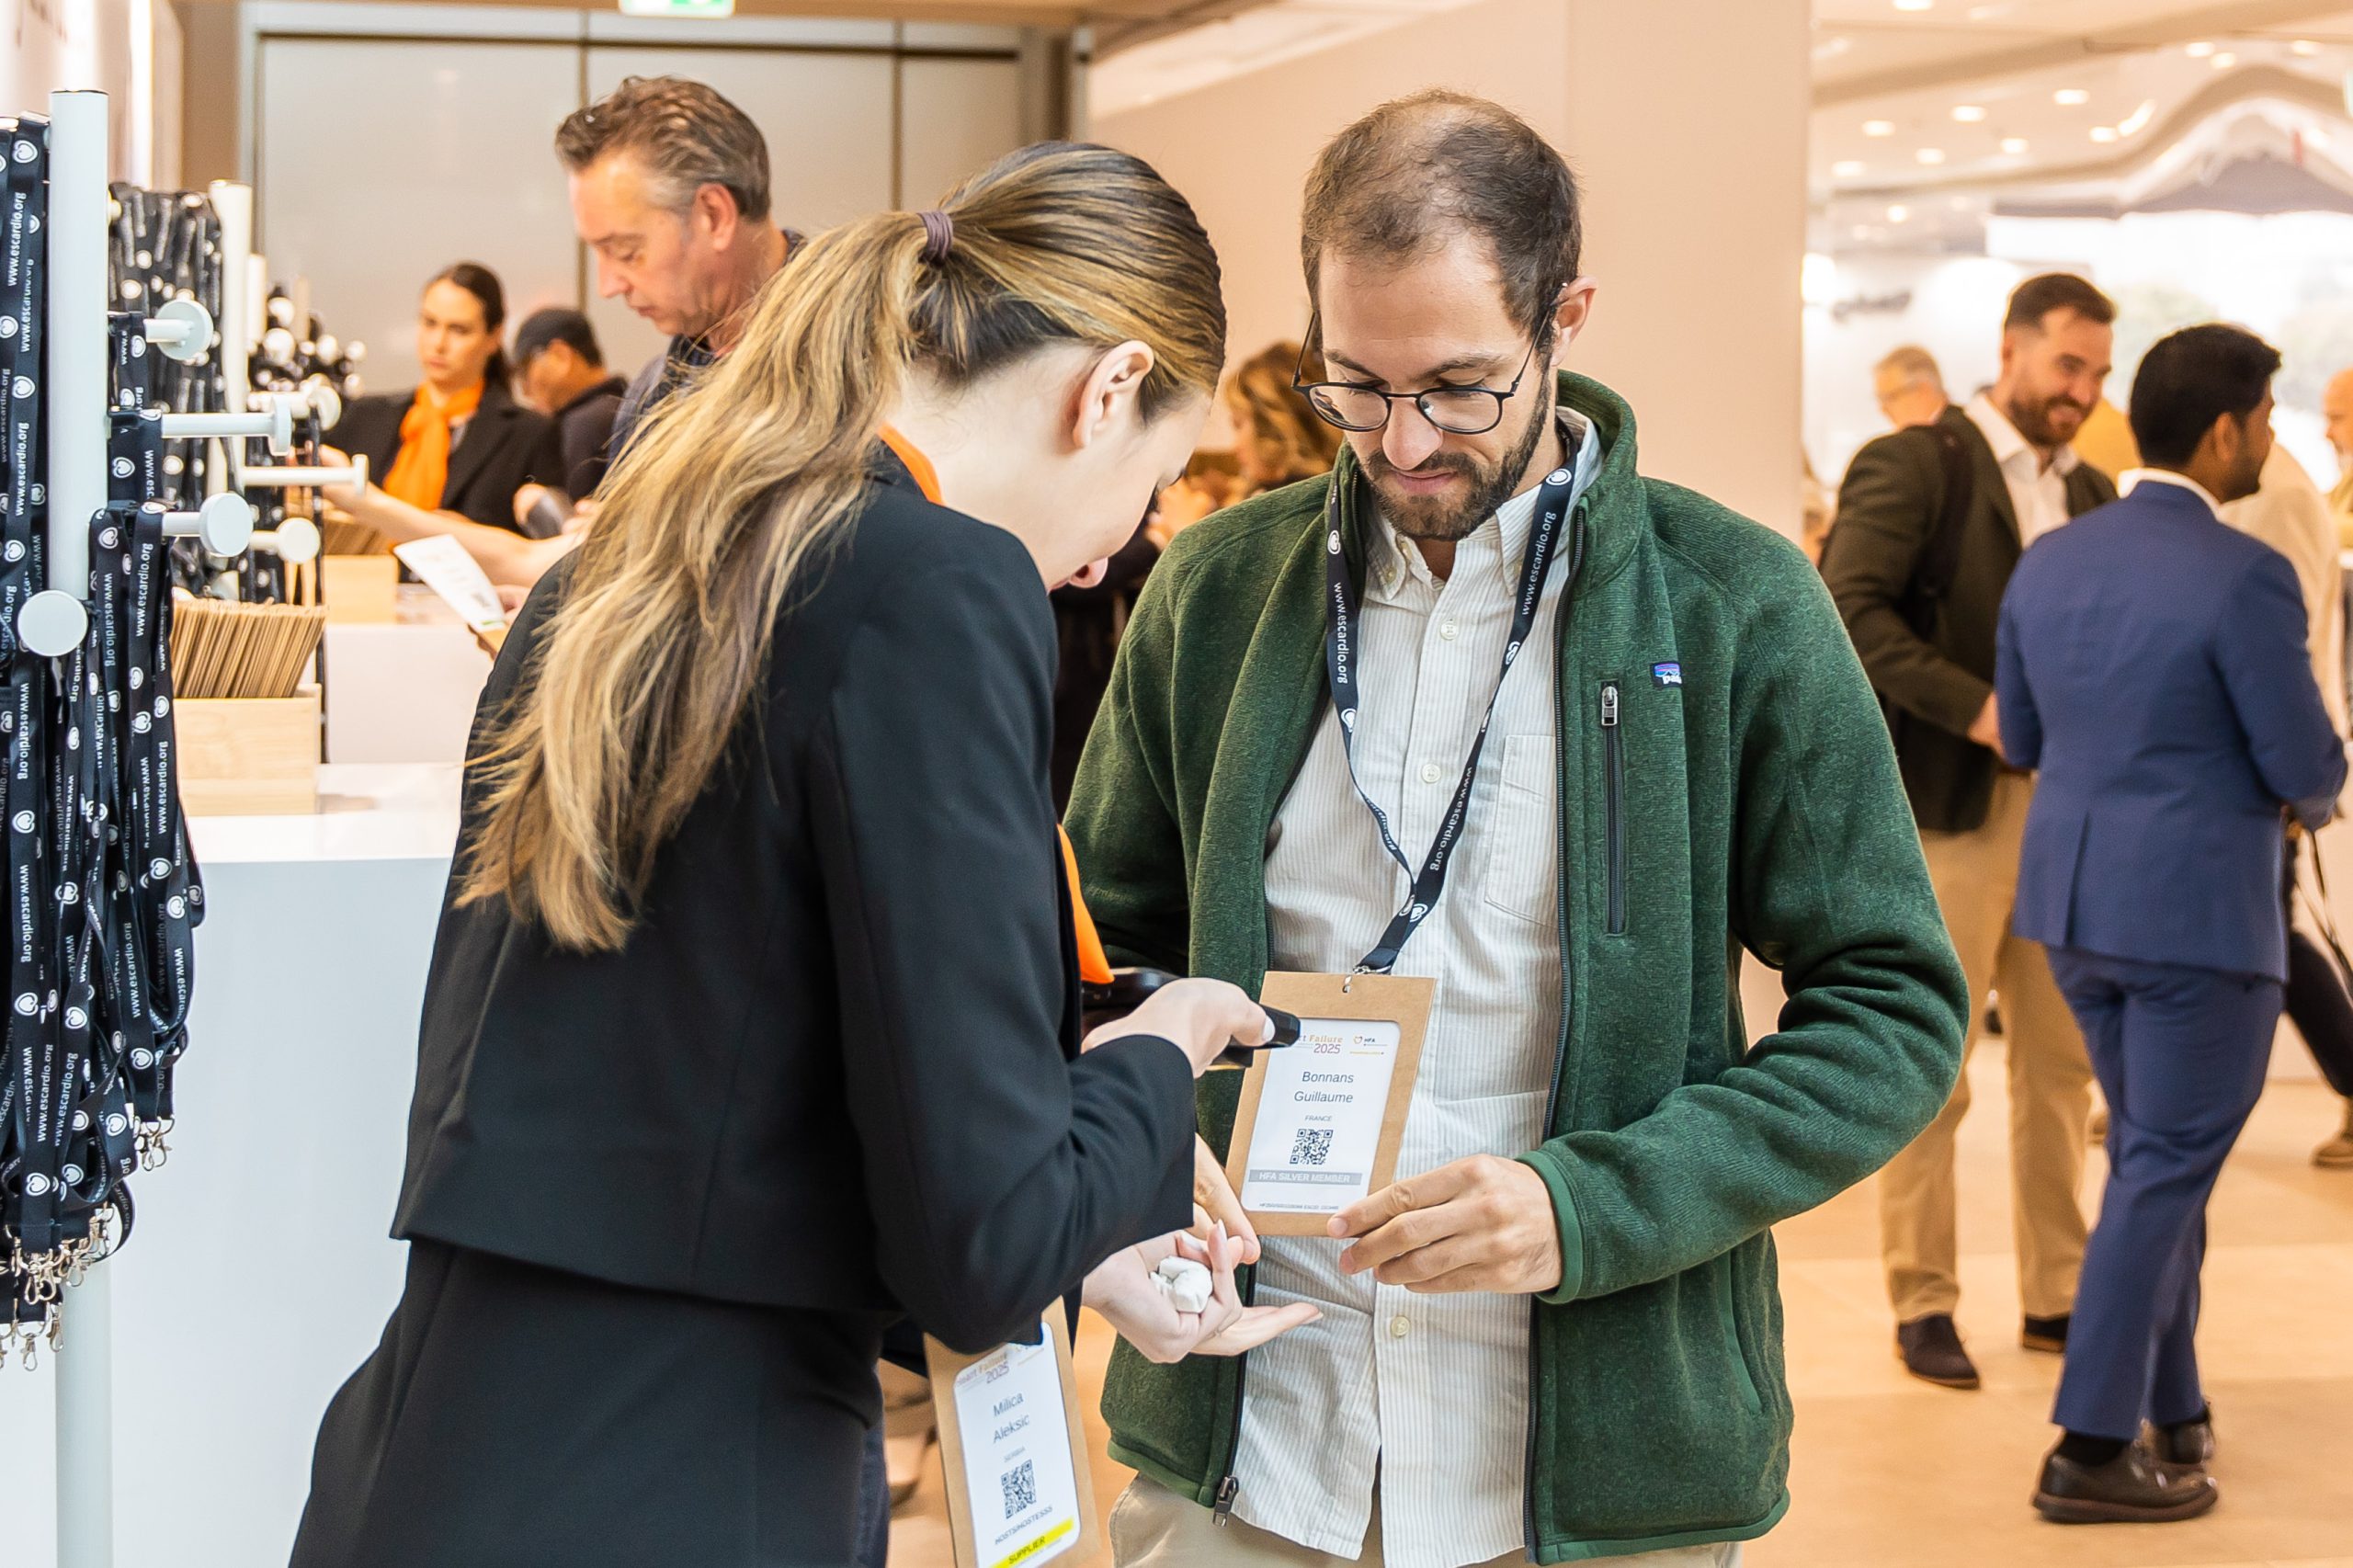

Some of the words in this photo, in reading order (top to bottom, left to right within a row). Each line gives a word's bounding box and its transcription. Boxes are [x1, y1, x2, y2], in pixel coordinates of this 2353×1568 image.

[7, 191, 27, 287] www.escardio.org
[16, 422, 30, 517] www.escardio.org
[135, 542, 153, 637] www.escardio.org
[1522, 511, 1558, 616] www.escardio.org
[103, 573, 116, 667] www.escardio.org
[1333, 582, 1348, 685] www.escardio.org
[17, 683, 31, 780] www.escardio.org
[156, 741, 169, 835] www.escardio.org
[1428, 767, 1473, 872] www.escardio.org
[19, 864, 32, 963] www.escardio.org
[123, 922, 142, 1018] www.escardio.org
[1302, 1071, 1355, 1085] Bonnans
[1309, 1034, 1344, 1044] Failure
[1313, 1043, 1342, 1054] 2025
[38, 1044, 54, 1142] www.escardio.org
[54, 1052, 79, 1147] www.escardio.org
[1293, 1090, 1354, 1104] Guillaume
[1304, 1114, 1333, 1122] FRANCE
[1259, 1172, 1277, 1181] HFA
[1279, 1173, 1310, 1182] SILVER
[1311, 1174, 1351, 1184] MEMBER
[985, 1361, 1010, 1384] 2025
[994, 1392, 1024, 1417] Milica
[994, 1415, 1030, 1444] Aleksic
[1008, 1535, 1046, 1564] SUPPLIER
